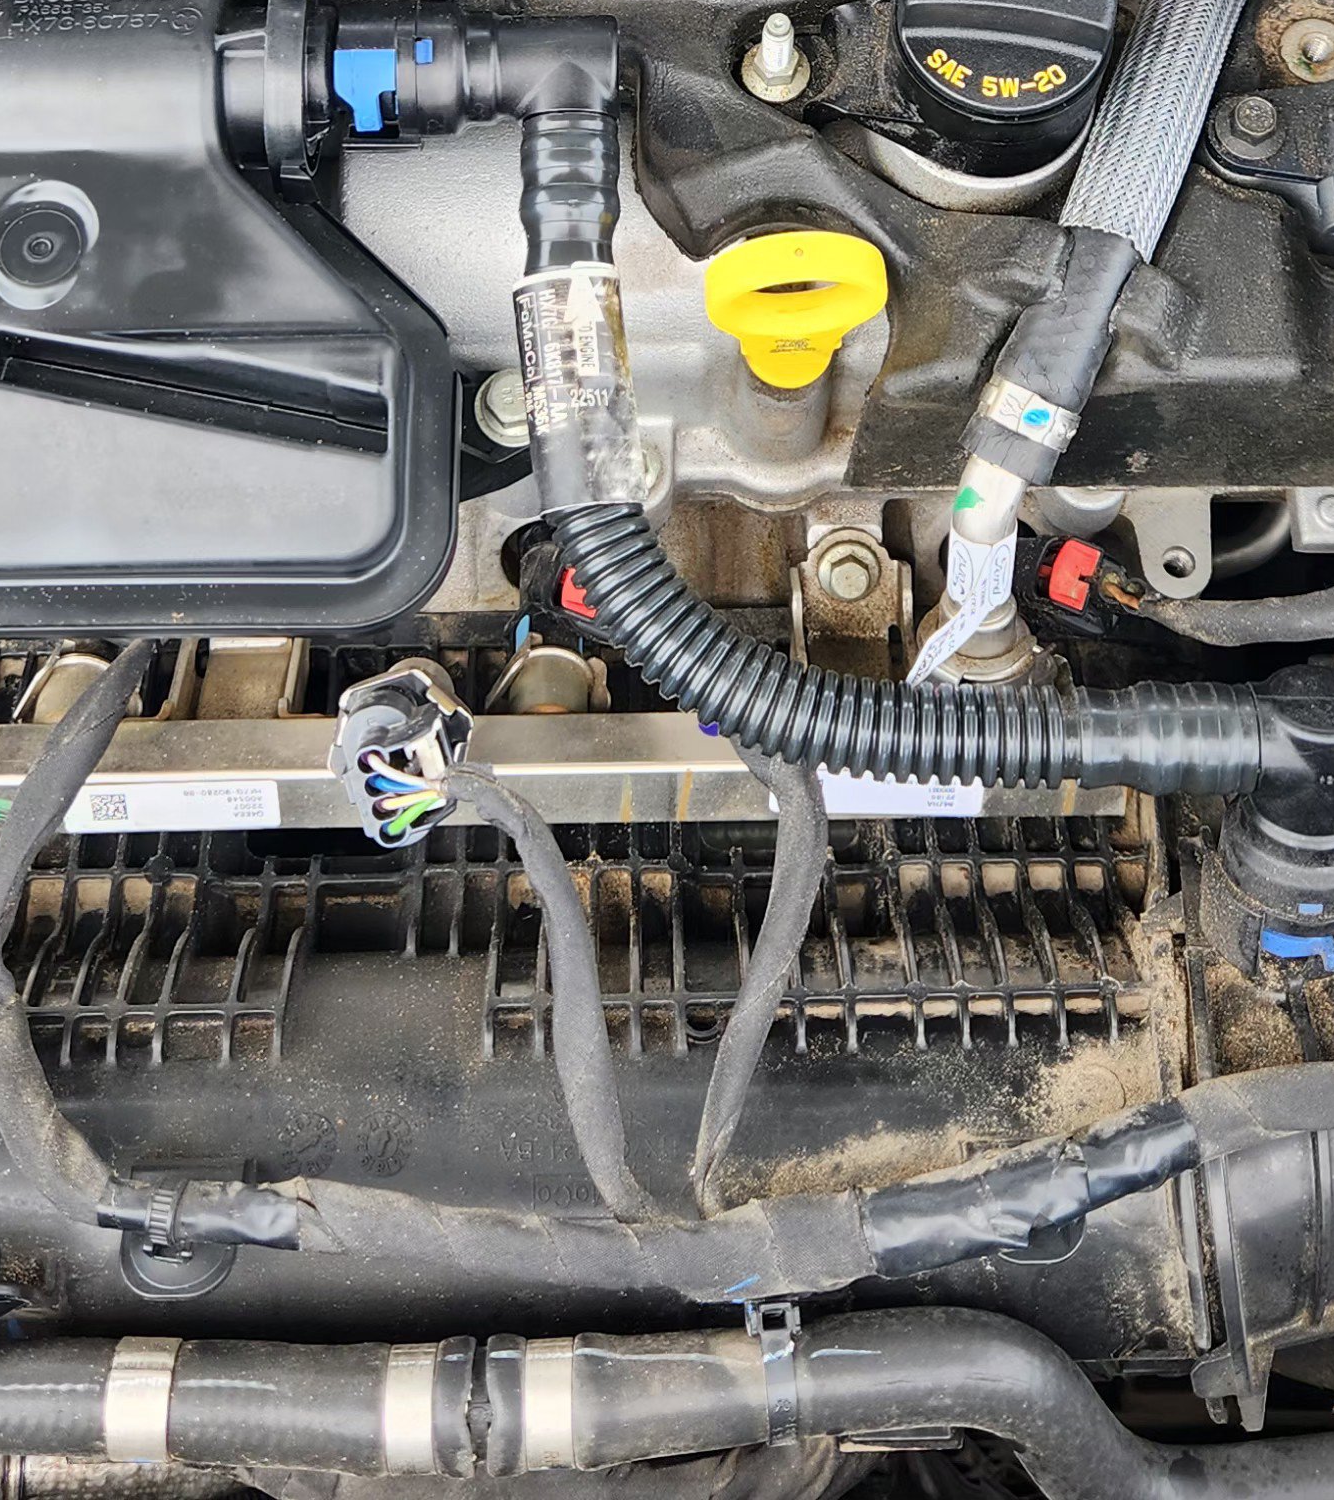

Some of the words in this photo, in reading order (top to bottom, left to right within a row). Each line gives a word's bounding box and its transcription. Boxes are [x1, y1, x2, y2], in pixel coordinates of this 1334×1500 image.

[926, 48, 974, 89] SAE
[981, 63, 1067, 98] 5W-20
[518, 297, 538, 382] FoMoCo
[579, 332, 596, 371] ENGINE
[569, 386, 610, 408] 22511
